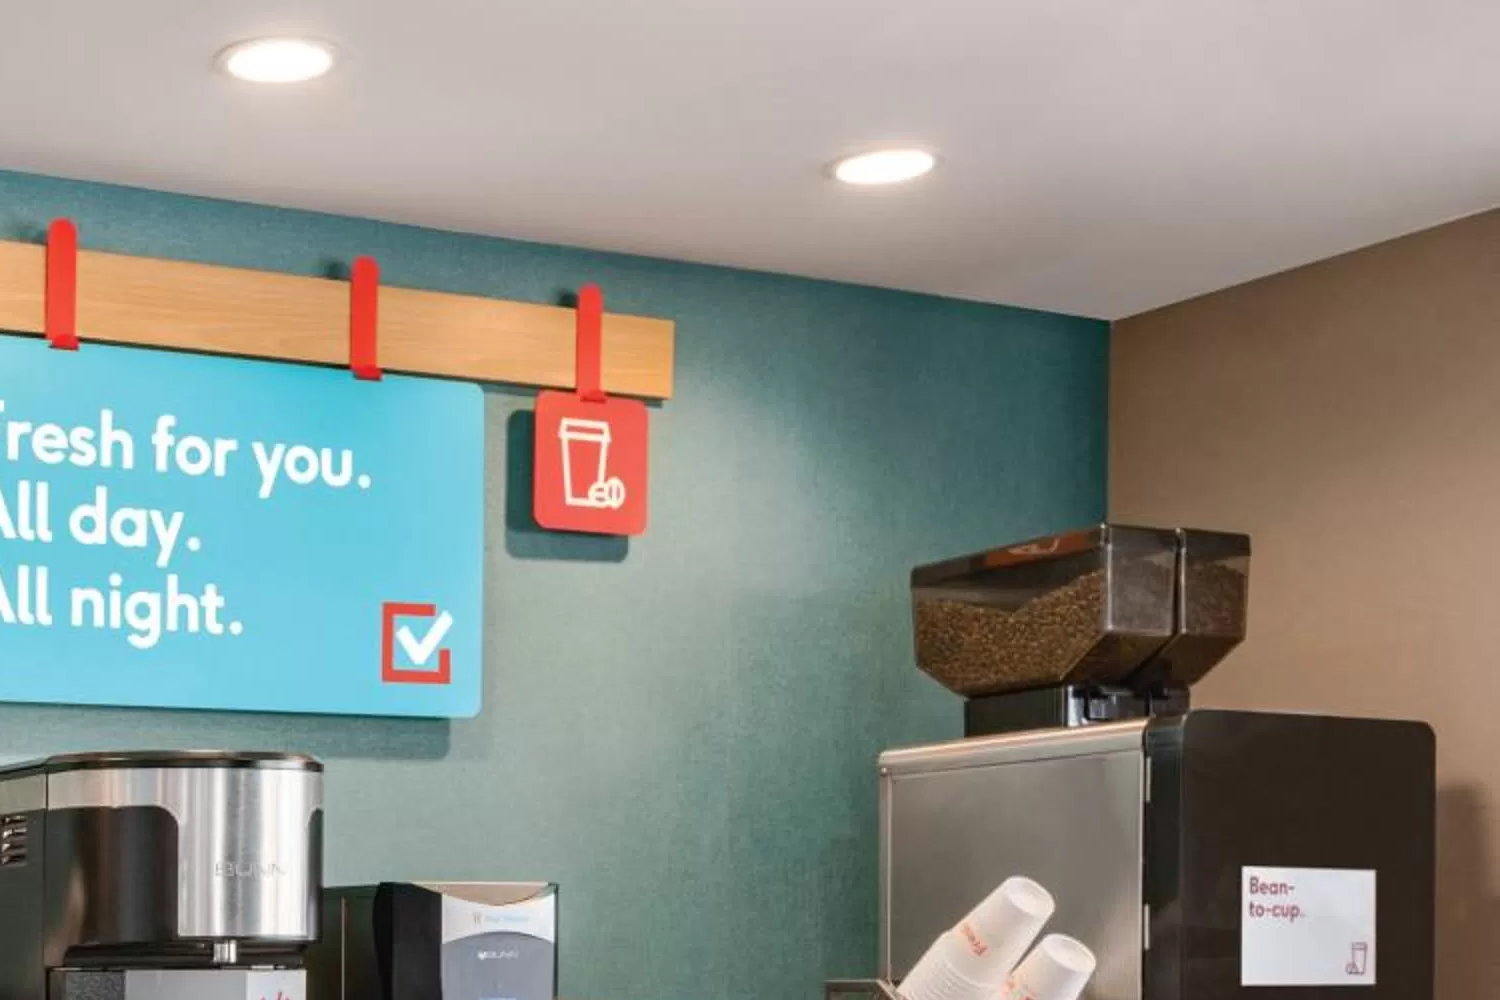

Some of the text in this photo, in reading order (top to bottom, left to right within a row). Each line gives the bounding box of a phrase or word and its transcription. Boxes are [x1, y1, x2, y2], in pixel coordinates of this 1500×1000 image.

[151, 413, 239, 477] for
[251, 440, 371, 499] you.
[68, 485, 201, 568] day.
[70, 573, 244, 649] night.
[1248, 876, 1296, 896] Bean-
[1248, 901, 1307, 923] to-cup.
